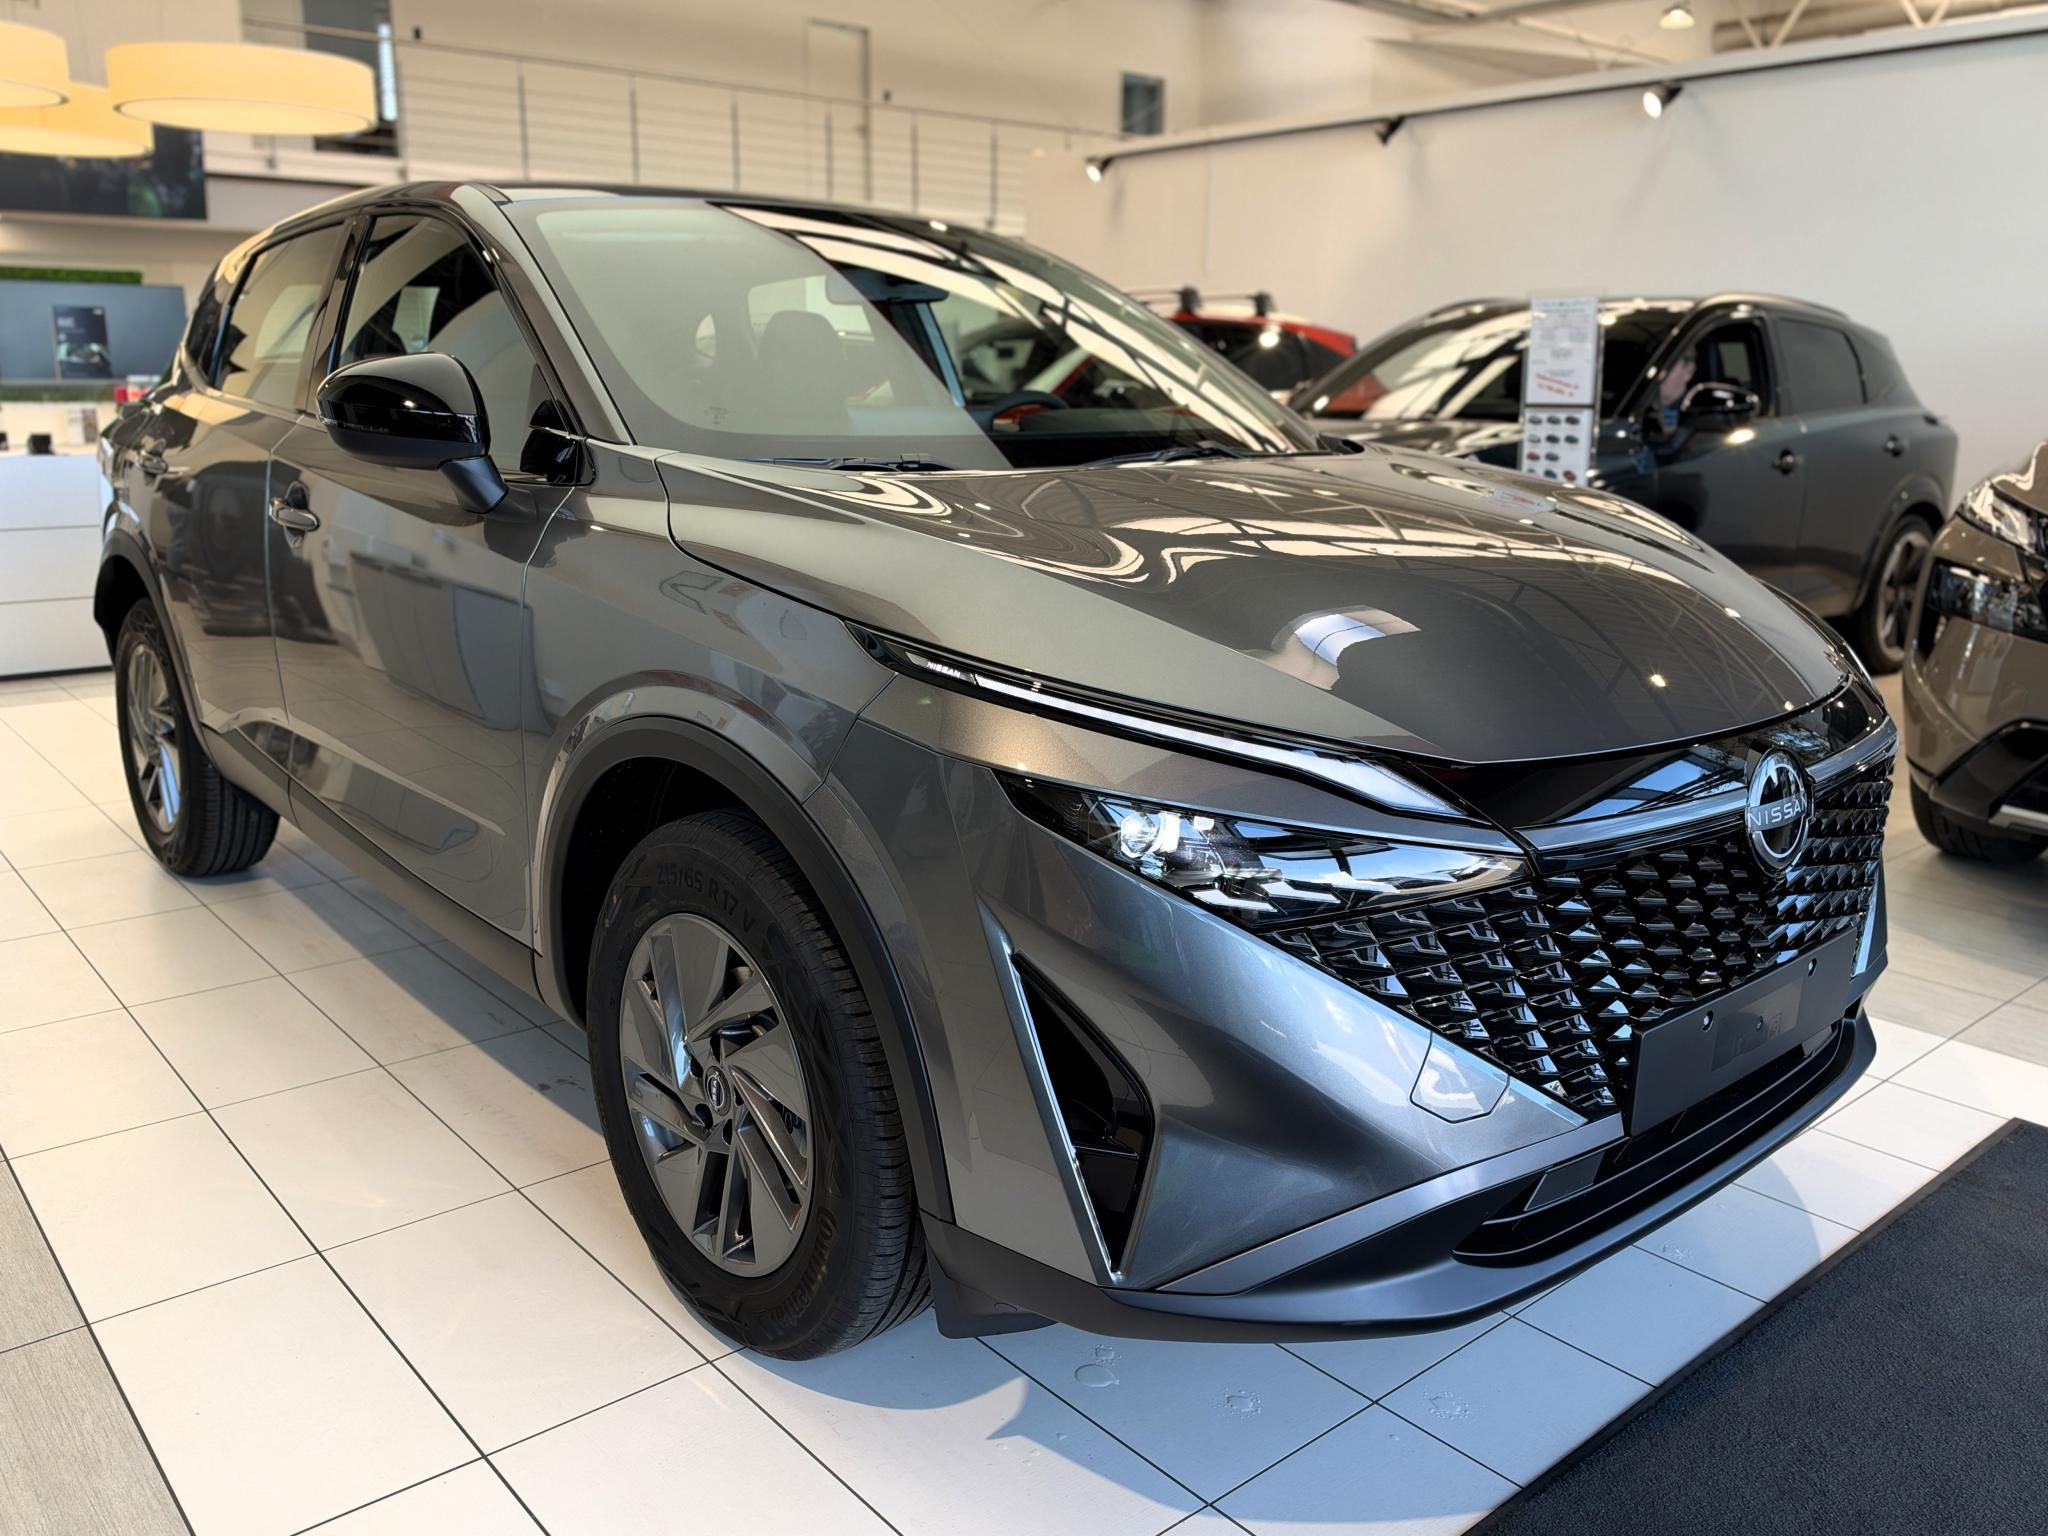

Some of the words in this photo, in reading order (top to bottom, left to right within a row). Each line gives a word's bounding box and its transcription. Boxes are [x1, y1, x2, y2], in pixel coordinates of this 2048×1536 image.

[926, 661, 961, 678] NISSAN
[1748, 796, 1807, 827] NISSAN
[657, 863, 703, 892] 215/65
[709, 878, 719, 904] R
[722, 889, 738, 916] 17
